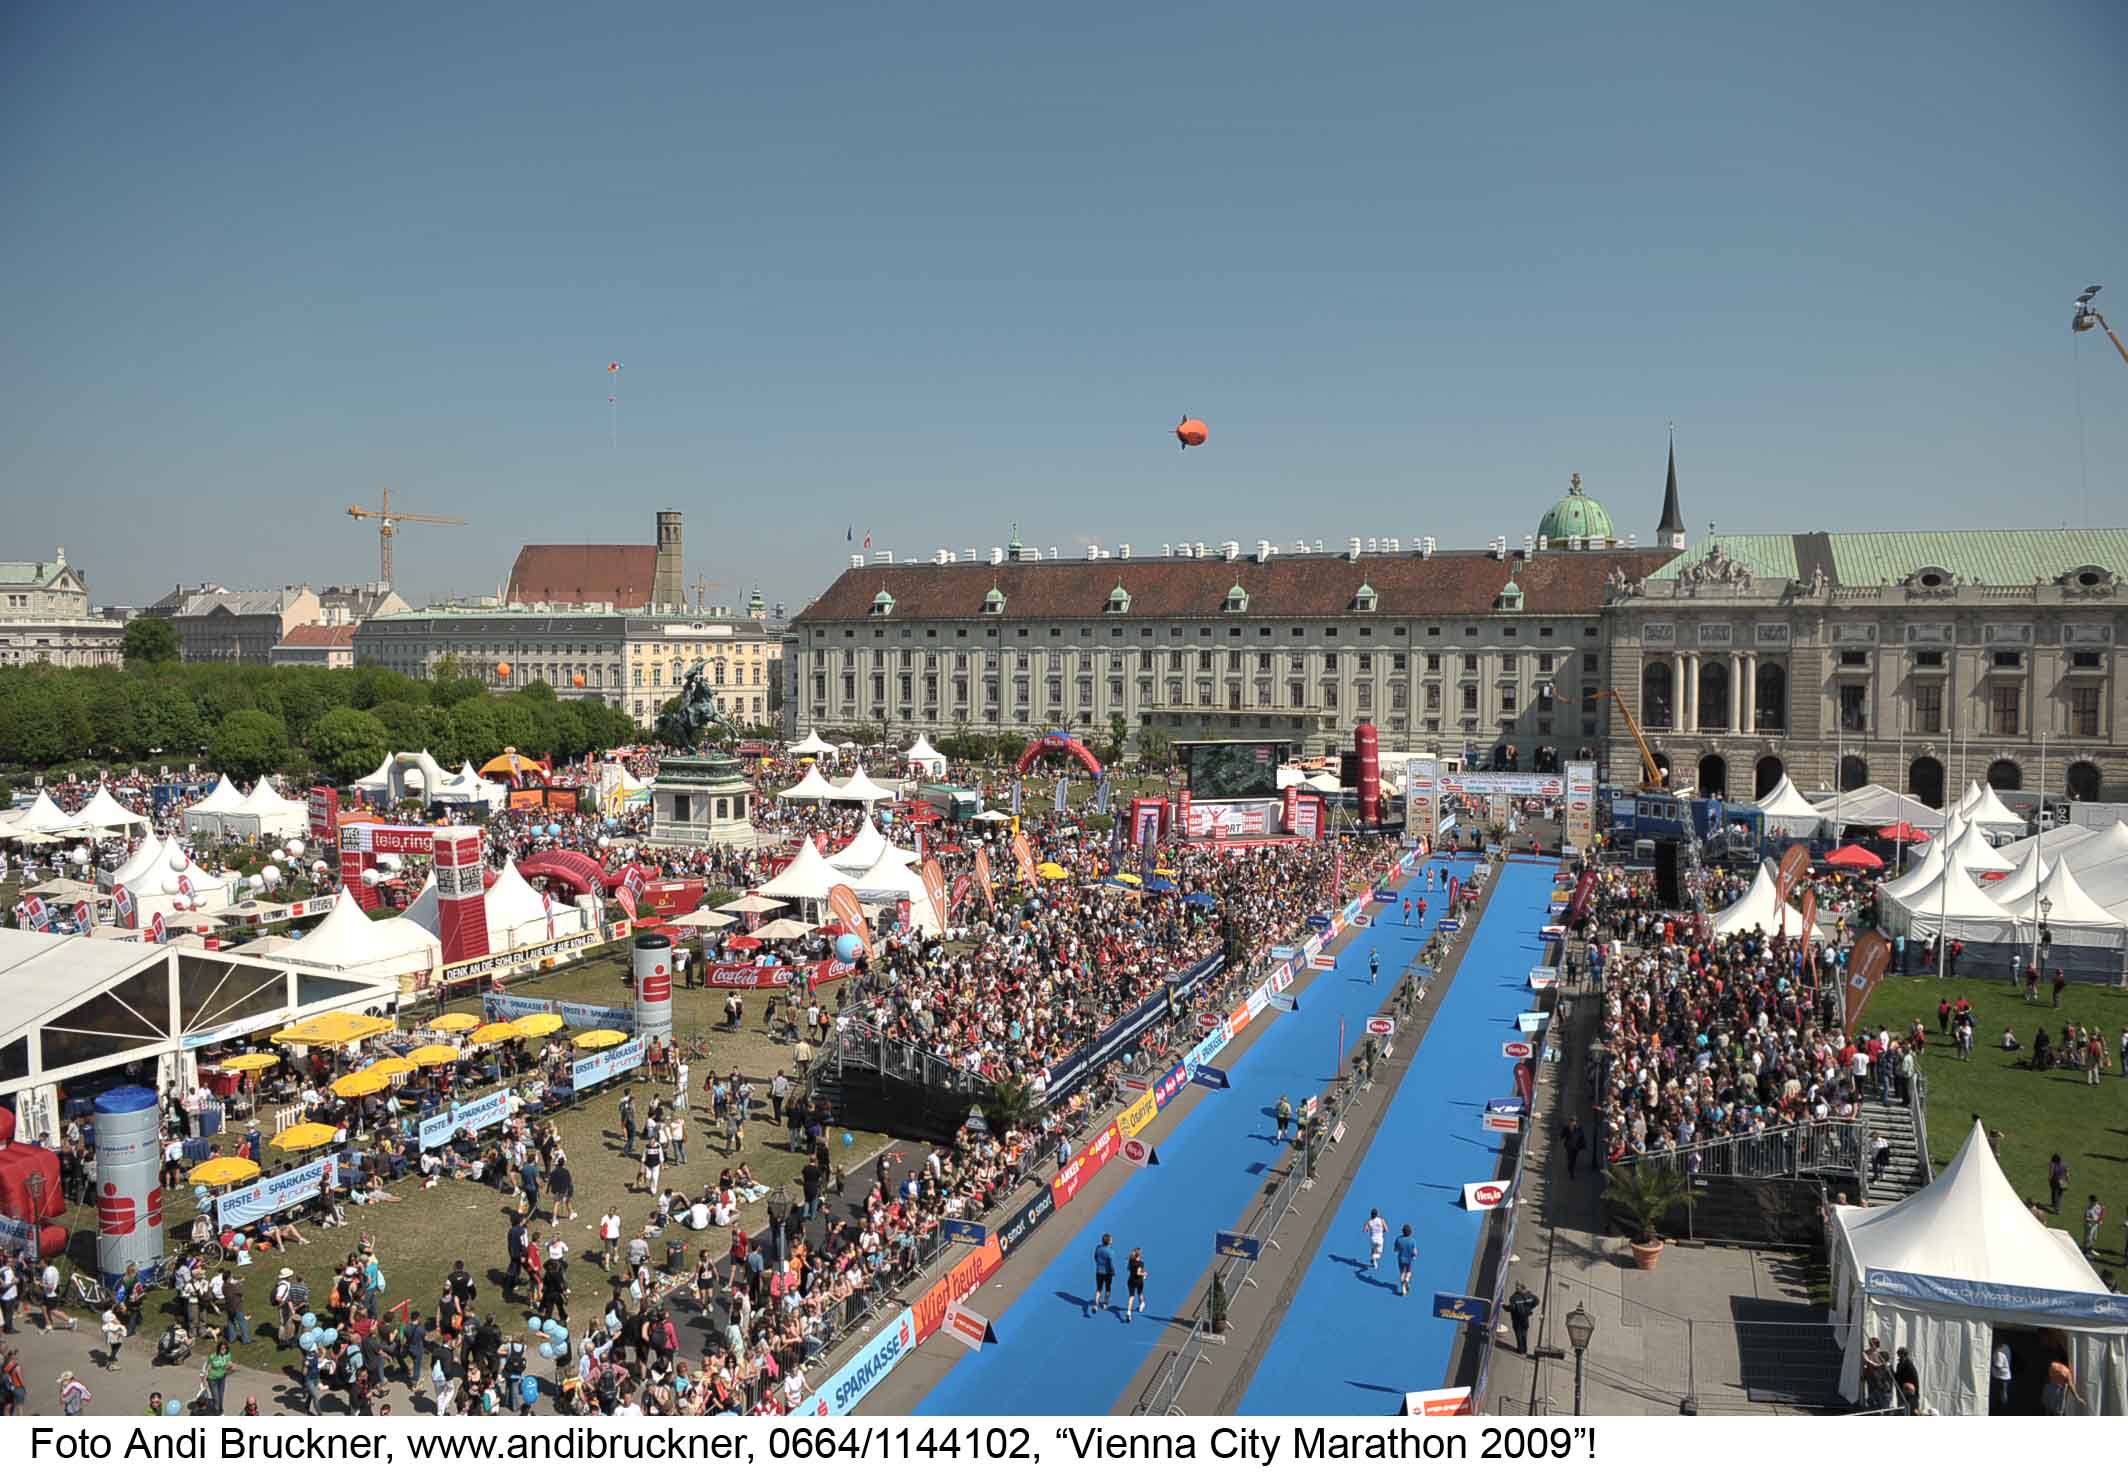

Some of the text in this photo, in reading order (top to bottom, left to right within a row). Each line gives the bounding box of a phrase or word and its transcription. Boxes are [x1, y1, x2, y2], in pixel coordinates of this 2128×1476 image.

[447, 967, 468, 980] DENK
[424, 1098, 498, 1135] ERSTE SPARKASSE
[222, 1167, 322, 1212] ERSTE SPARKASSE
[951, 1257, 983, 1302] heute
[835, 1336, 900, 1409] SPARKASSE
